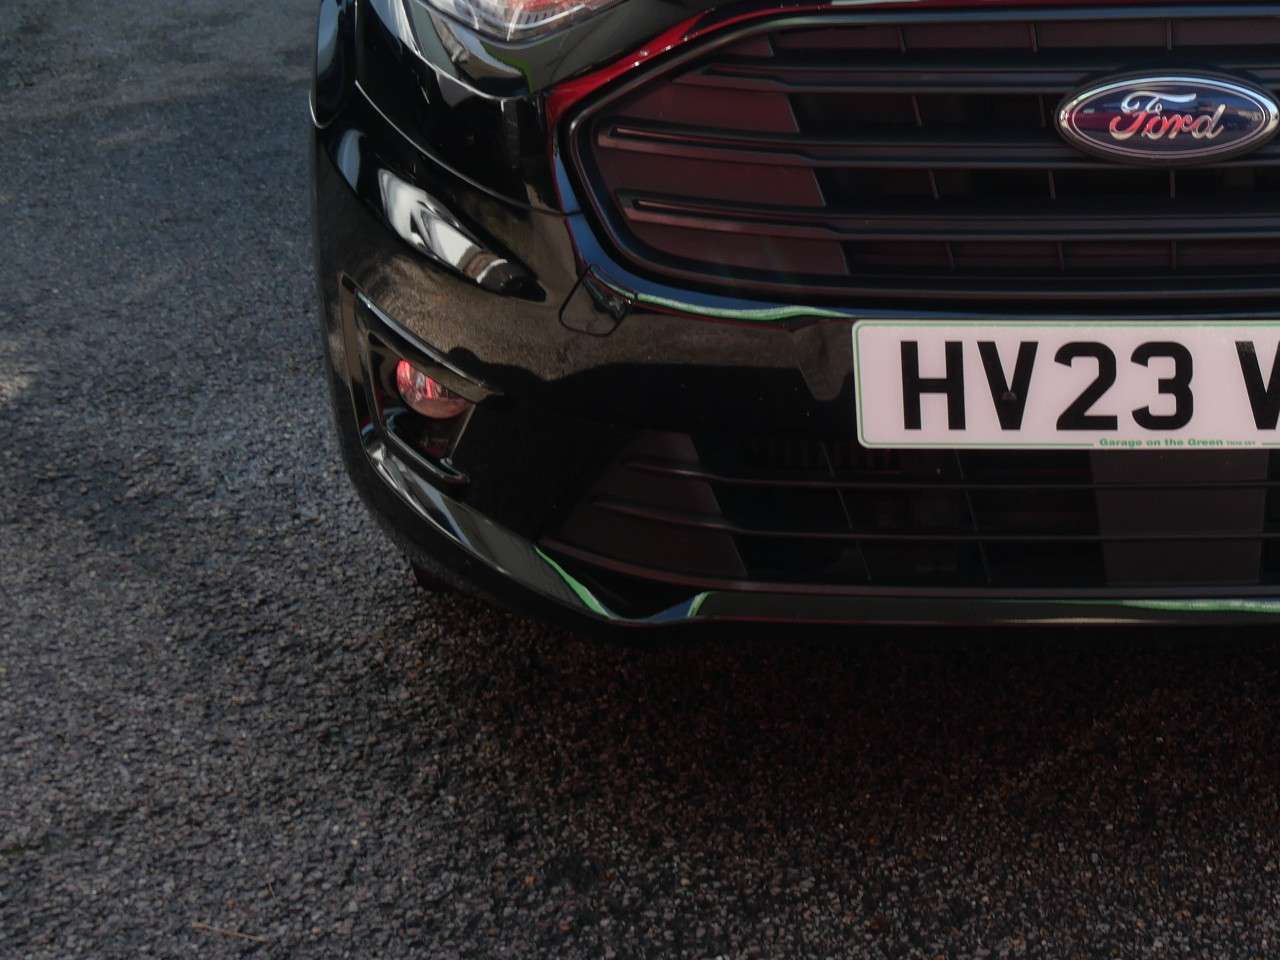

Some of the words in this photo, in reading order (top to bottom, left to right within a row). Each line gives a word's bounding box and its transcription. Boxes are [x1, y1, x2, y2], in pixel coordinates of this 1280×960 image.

[1108, 90, 1227, 140] Ford
[900, 340, 1194, 431] HV23
[1099, 438, 1142, 448] Garage
[1164, 438, 1184, 447] the
[1187, 438, 1224, 447] Green
